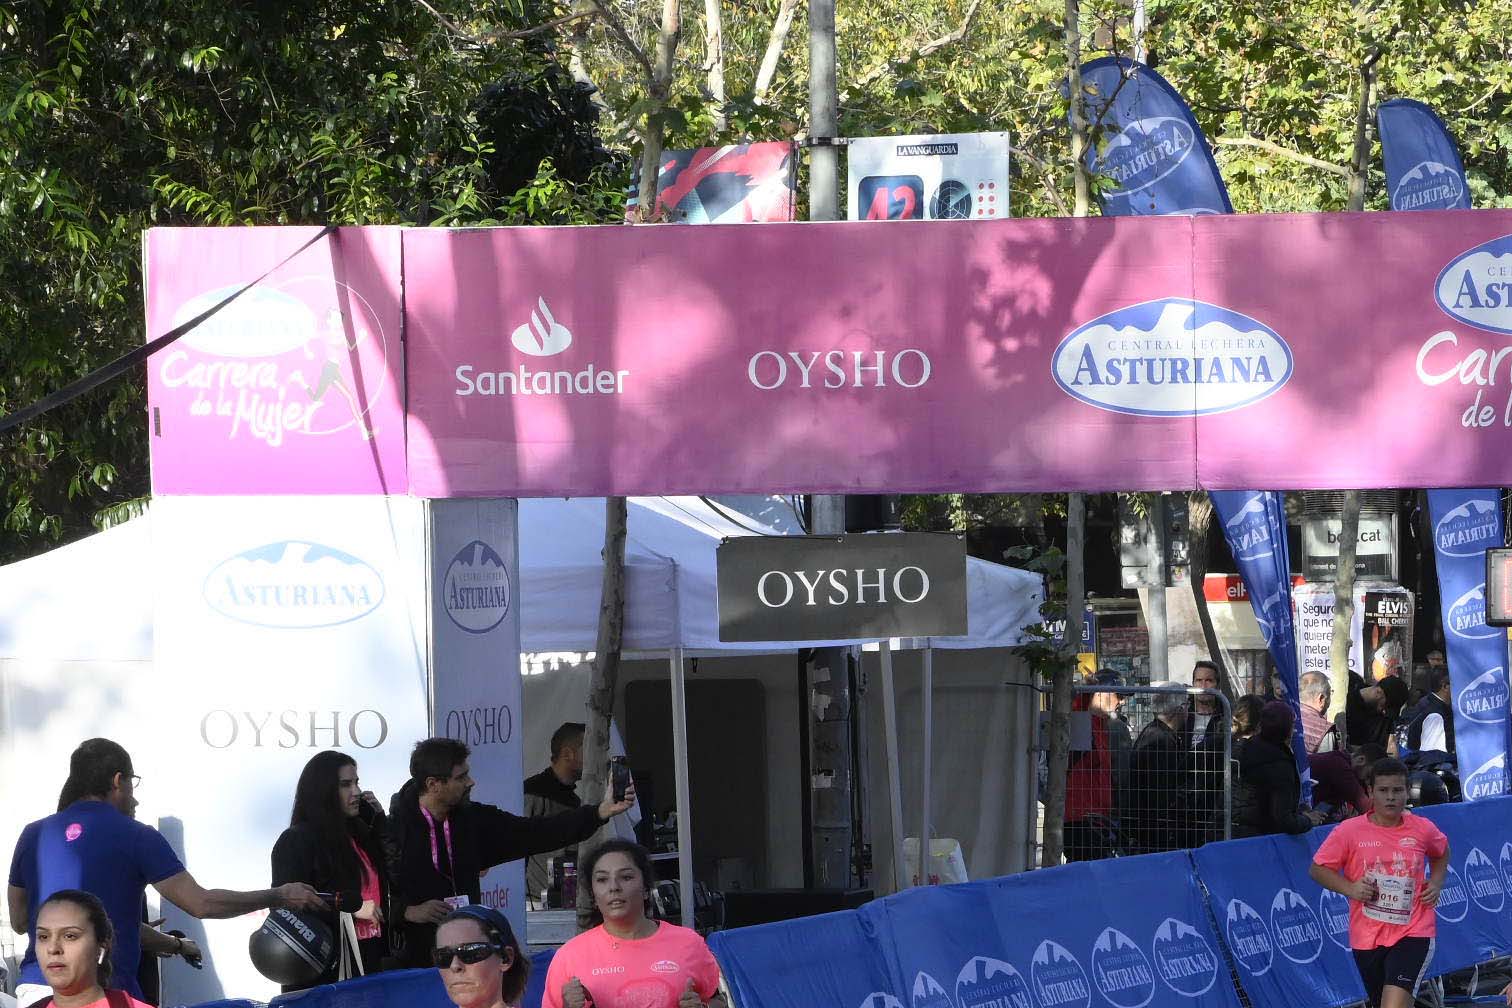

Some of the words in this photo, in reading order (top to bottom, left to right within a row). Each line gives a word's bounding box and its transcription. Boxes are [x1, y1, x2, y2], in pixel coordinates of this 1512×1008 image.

[909, 143, 957, 155] VANGUARDIA
[1108, 340, 1183, 351] CENTRAL
[1191, 338, 1266, 350] LECHERA
[160, 351, 278, 388] Carrera
[455, 364, 629, 396] Santander
[747, 348, 932, 390] OYSHO
[1071, 343, 1275, 386] ASTURIANA
[1461, 389, 1496, 427] de
[221, 575, 374, 608] ASTURIANA
[448, 579, 507, 611] ASTURIANA
[757, 566, 930, 608] OYSHO
[1377, 600, 1409, 614] ELVIS
[1303, 619, 1320, 630] que
[1305, 657, 1324, 669] este
[200, 709, 388, 749] OYSHO
[445, 704, 512, 747] OYSHO
[1380, 893, 1399, 902] 016
[275, 907, 317, 943] Blauer
[1036, 976, 1087, 1008] ASTURIANA
[1098, 960, 1152, 993] ASTURIANA
